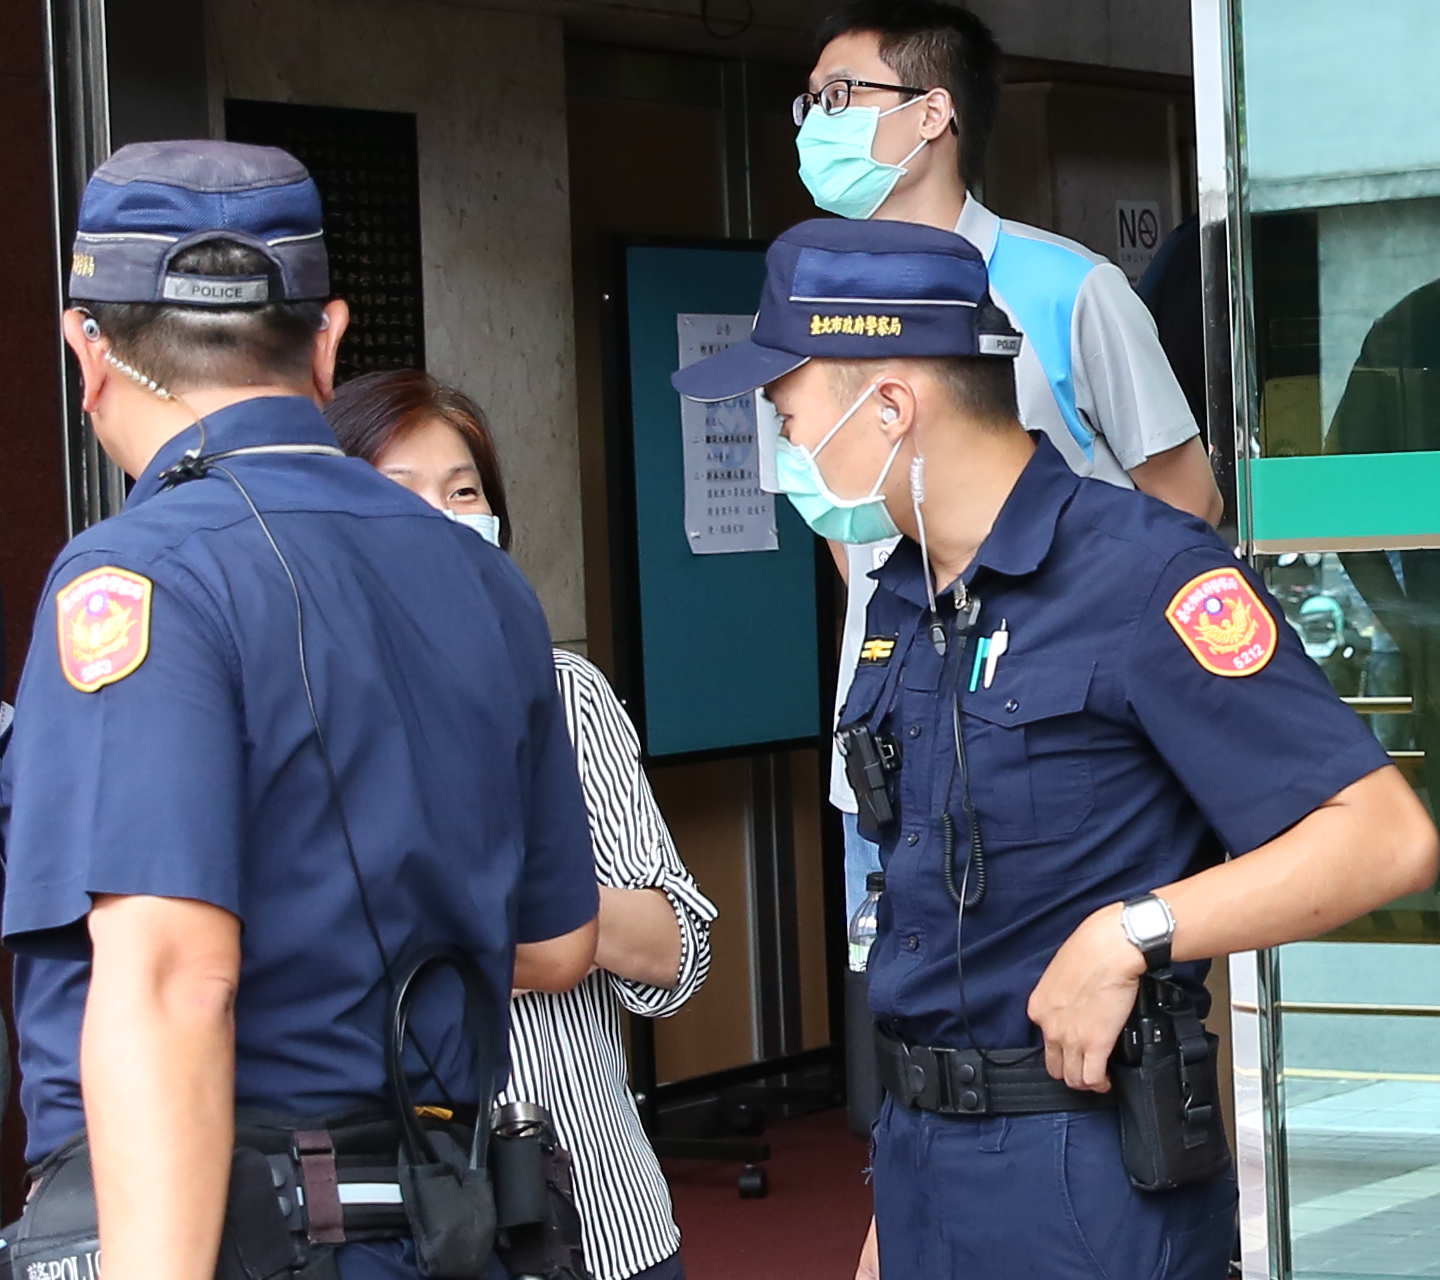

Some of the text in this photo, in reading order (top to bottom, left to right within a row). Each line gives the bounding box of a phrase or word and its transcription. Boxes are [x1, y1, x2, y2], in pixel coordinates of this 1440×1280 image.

[191, 285, 243, 298] POLICE
[810, 315, 902, 337] 臺北市政府警察局
[1233, 643, 1265, 670] 5212
